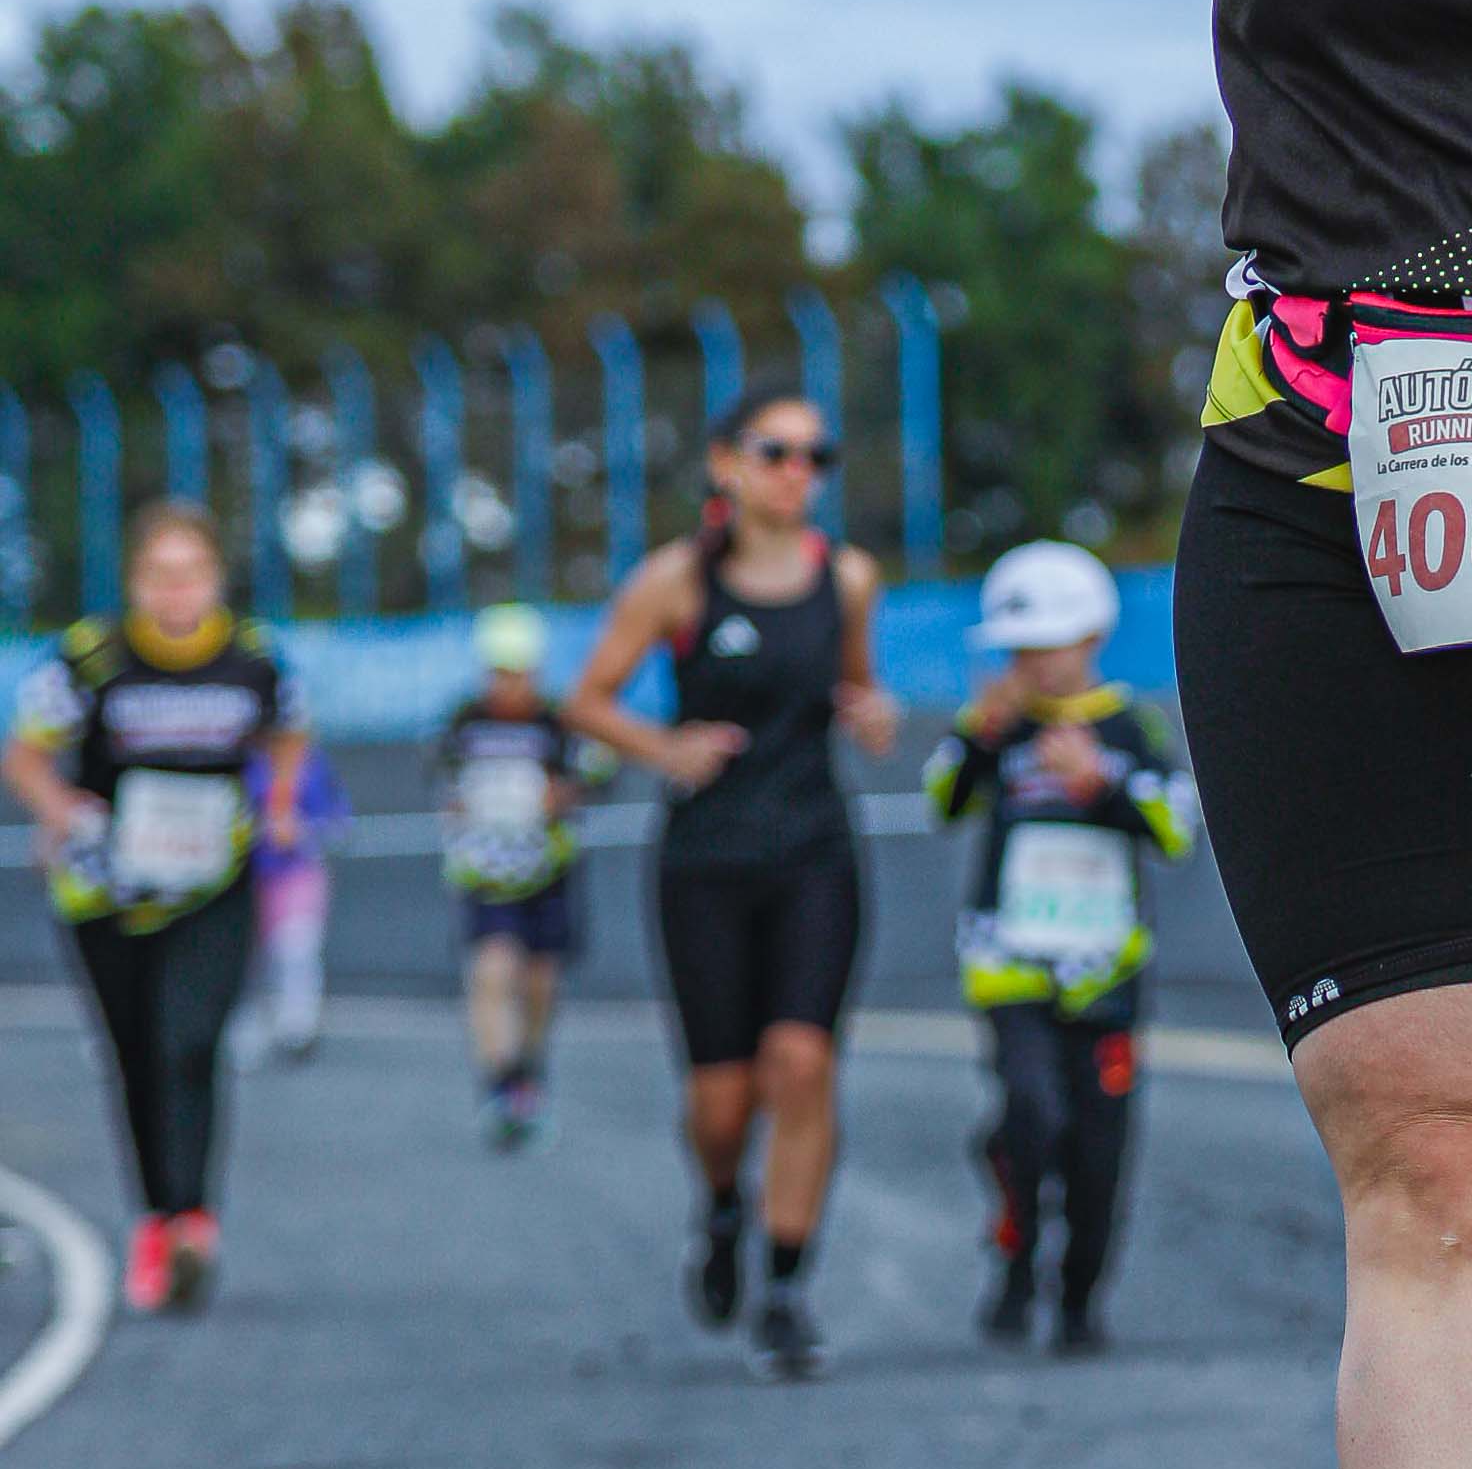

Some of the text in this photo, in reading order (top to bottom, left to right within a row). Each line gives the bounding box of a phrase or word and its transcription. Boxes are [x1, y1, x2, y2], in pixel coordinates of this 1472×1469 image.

[1377, 461, 1387, 475] La
[1388, 457, 1428, 472] Carrera
[1431, 455, 1448, 468] de
[1450, 453, 1469, 466] los
